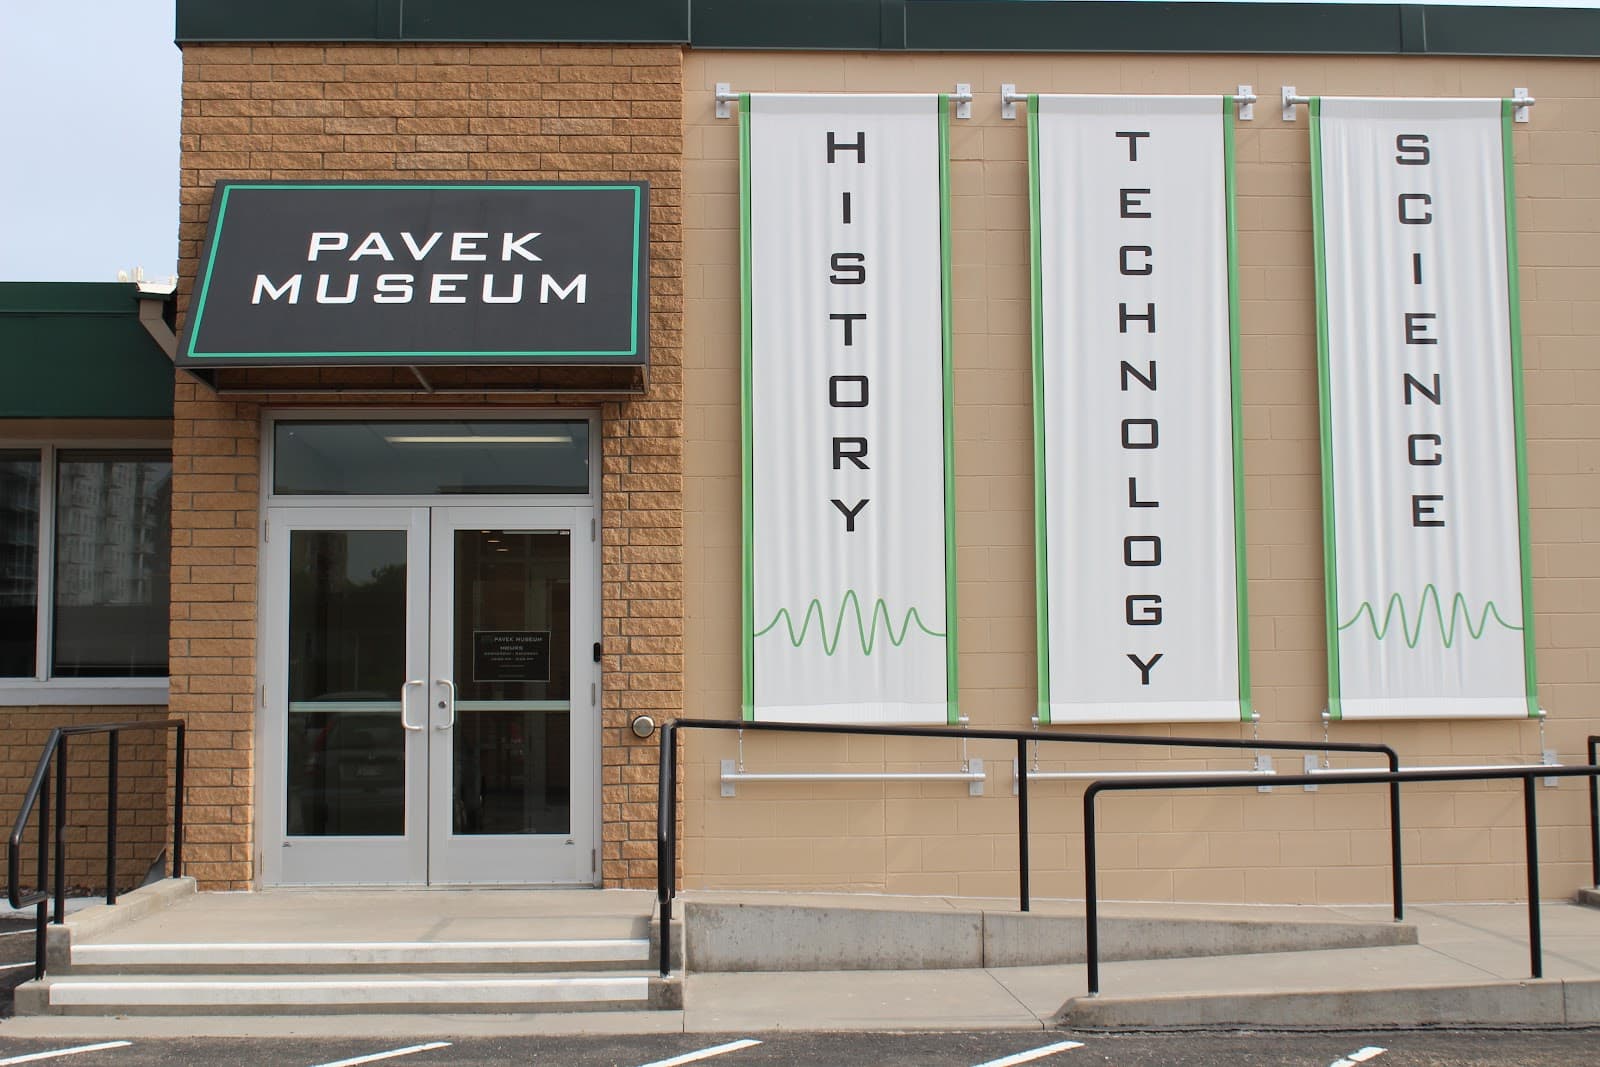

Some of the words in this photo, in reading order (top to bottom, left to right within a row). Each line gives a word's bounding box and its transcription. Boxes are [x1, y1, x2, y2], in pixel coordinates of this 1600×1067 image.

[251, 273, 587, 305] MUSEUM
[307, 231, 543, 262] PAVEK
[826, 131, 871, 532] HISTORY
[1115, 131, 1164, 685] TECHNOLOGY
[1395, 134, 1445, 528] SCIENCE
